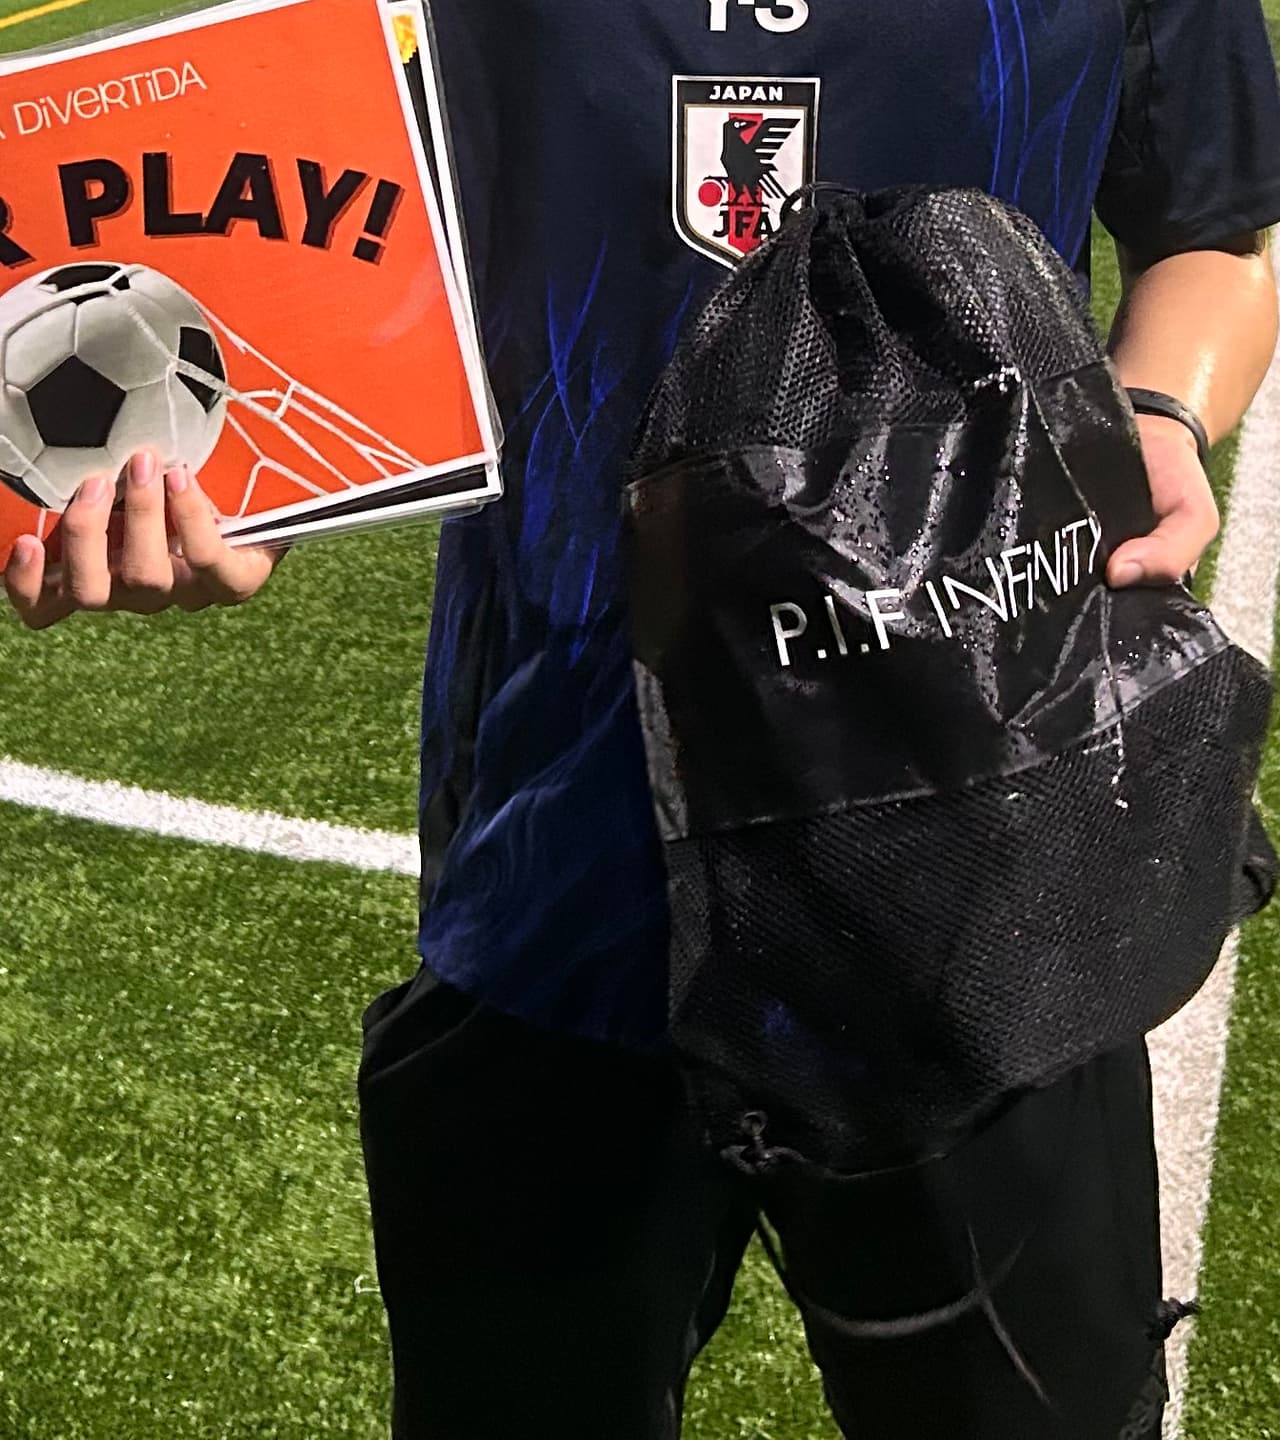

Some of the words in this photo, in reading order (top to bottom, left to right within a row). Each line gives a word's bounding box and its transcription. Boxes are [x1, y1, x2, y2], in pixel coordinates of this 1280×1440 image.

[709, 85, 784, 102] JAPAN
[58, 152, 405, 266] PLAY!
[712, 210, 773, 239] JFA
